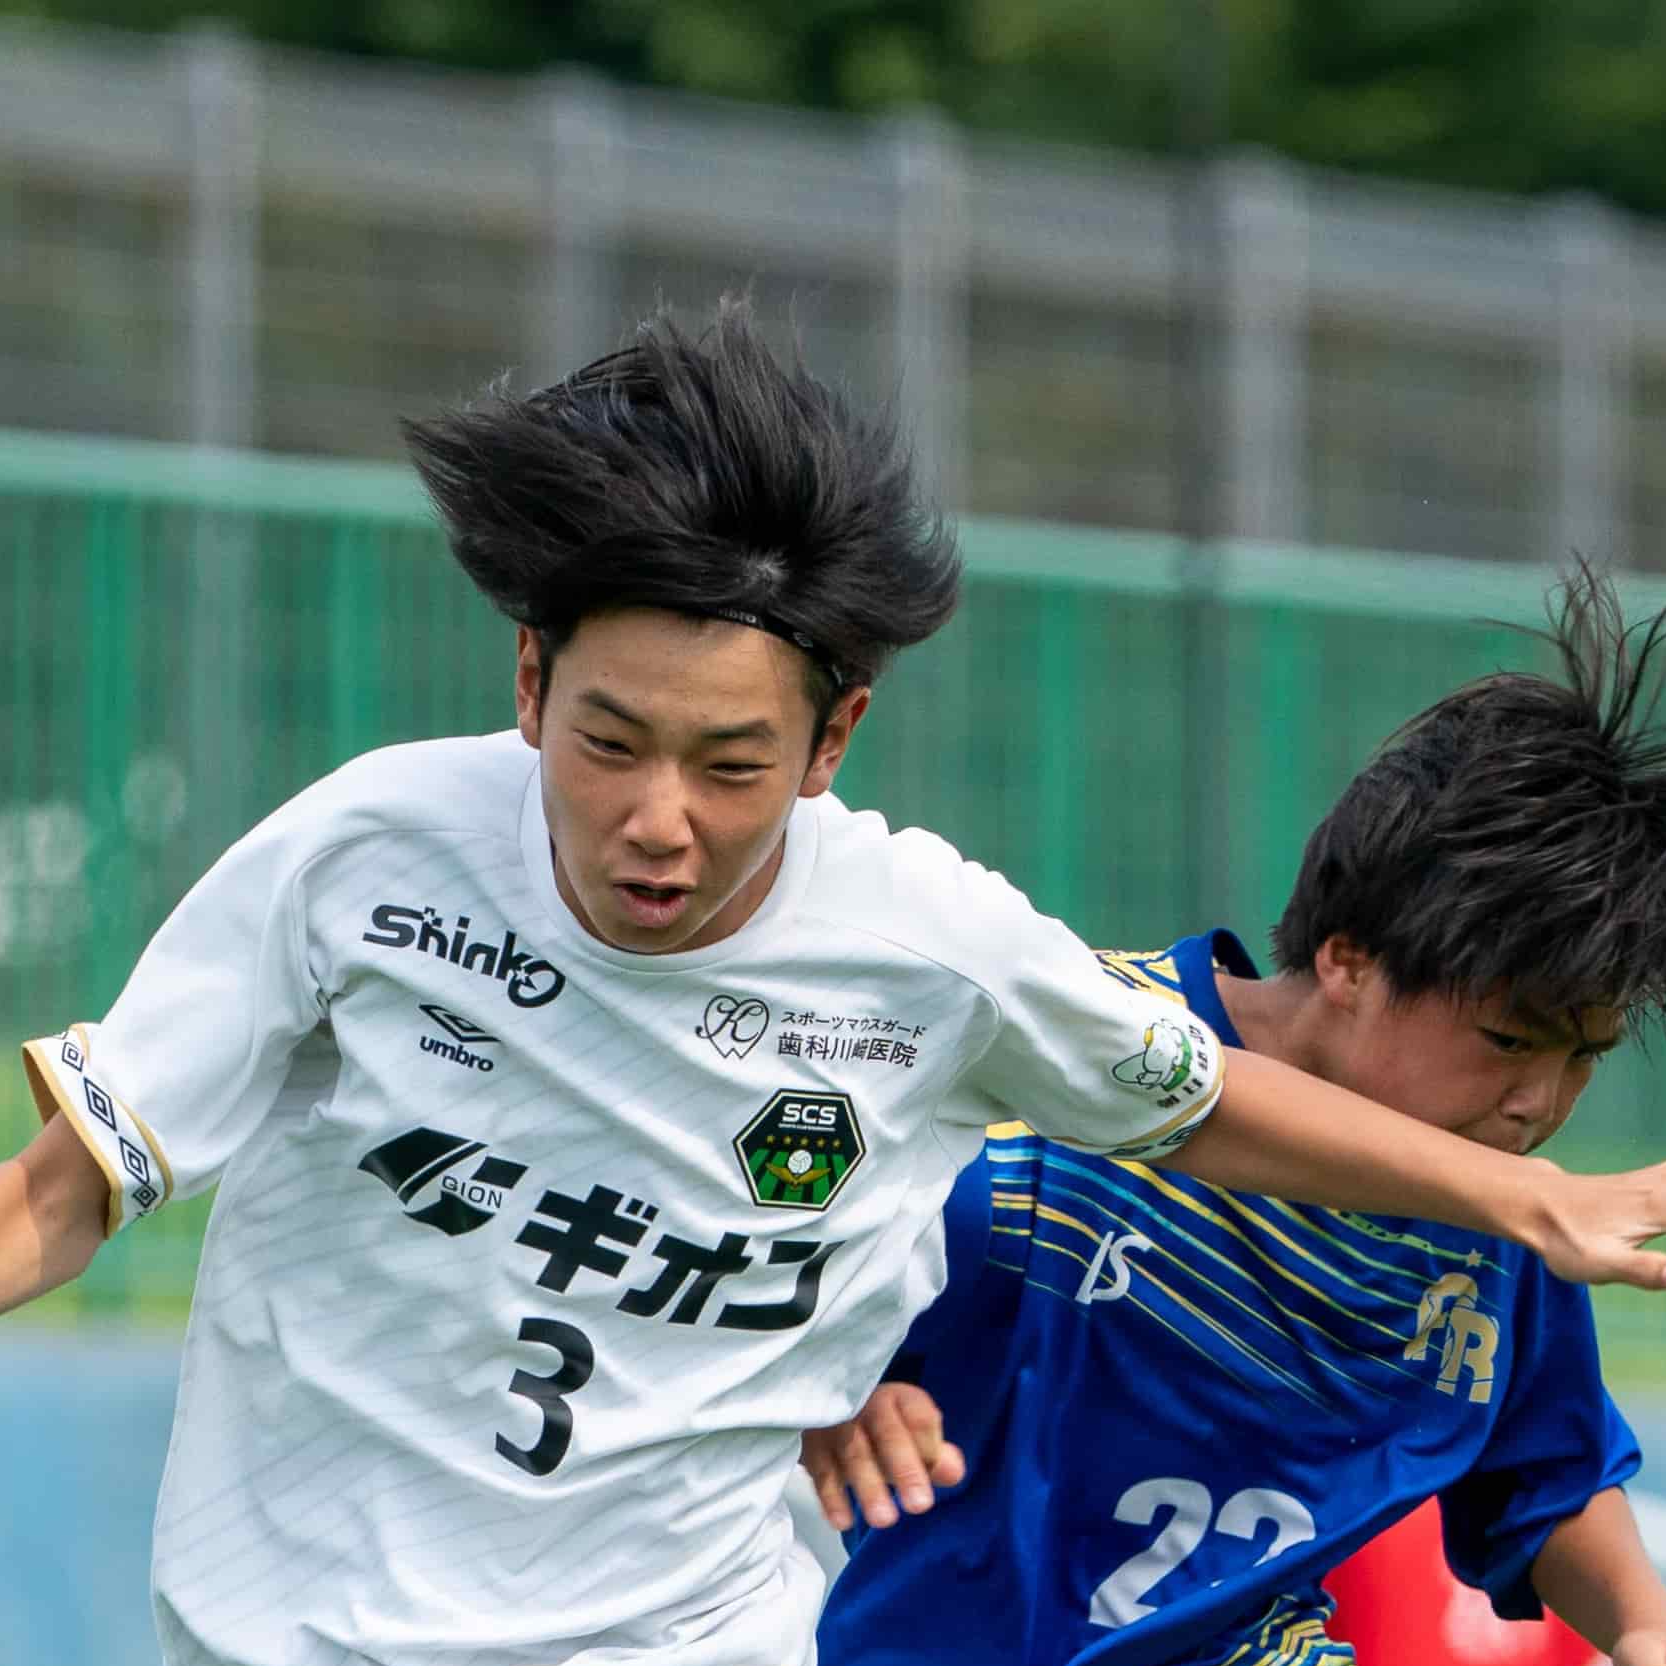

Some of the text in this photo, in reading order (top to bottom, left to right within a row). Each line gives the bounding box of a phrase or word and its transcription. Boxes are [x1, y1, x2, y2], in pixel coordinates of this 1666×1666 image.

[780, 1010, 928, 1039] スポーツマウスガード
[419, 1036, 494, 1072] umbro
[781, 1102, 838, 1126] SCS
[441, 1175, 503, 1209] GION
[514, 1184, 848, 1331] ギオン
[495, 1317, 595, 1477] 3
